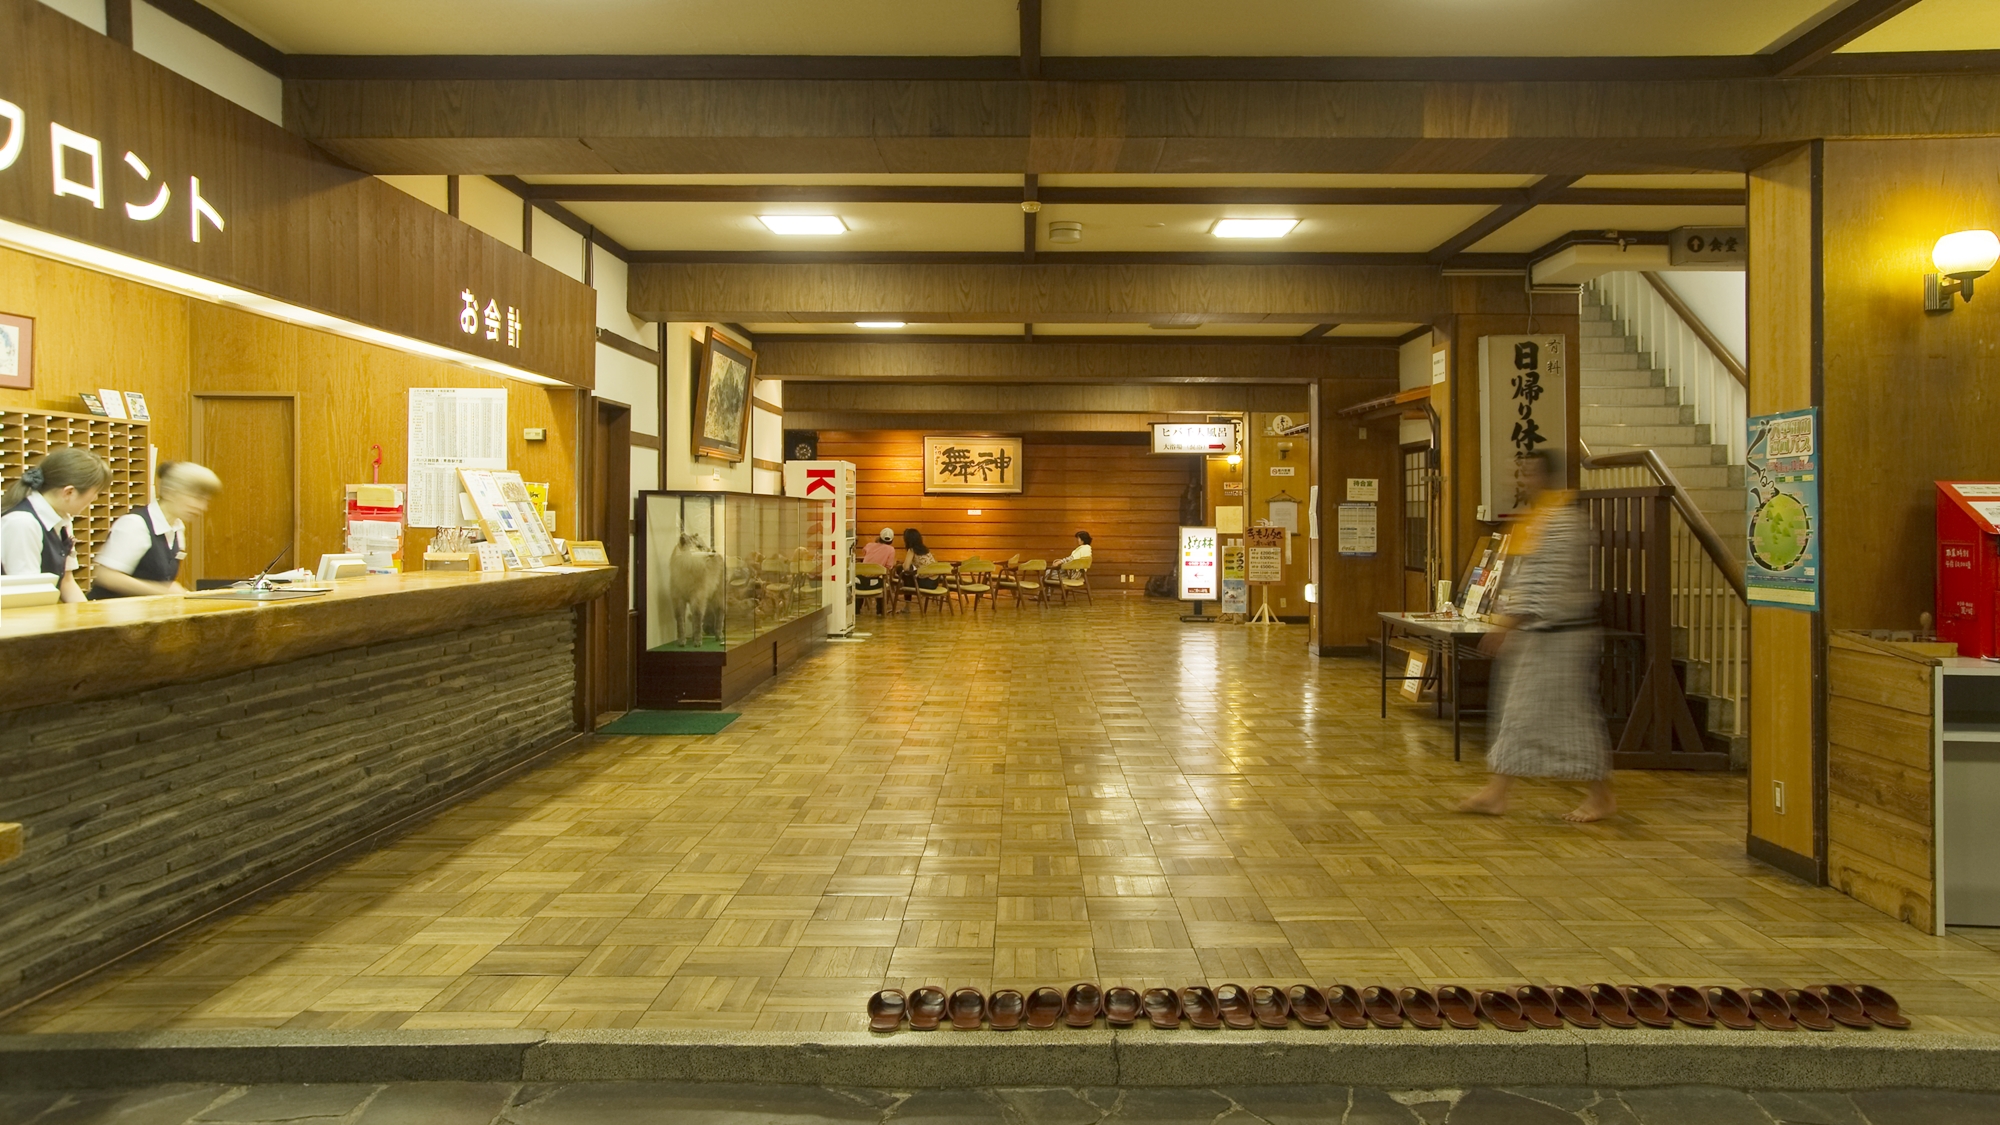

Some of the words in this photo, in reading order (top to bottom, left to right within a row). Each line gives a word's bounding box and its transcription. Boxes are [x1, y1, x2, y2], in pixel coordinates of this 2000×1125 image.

[1709, 236, 1738, 252] 食堂
[456, 288, 522, 349] お会計
[1545, 338, 1561, 375] 有料
